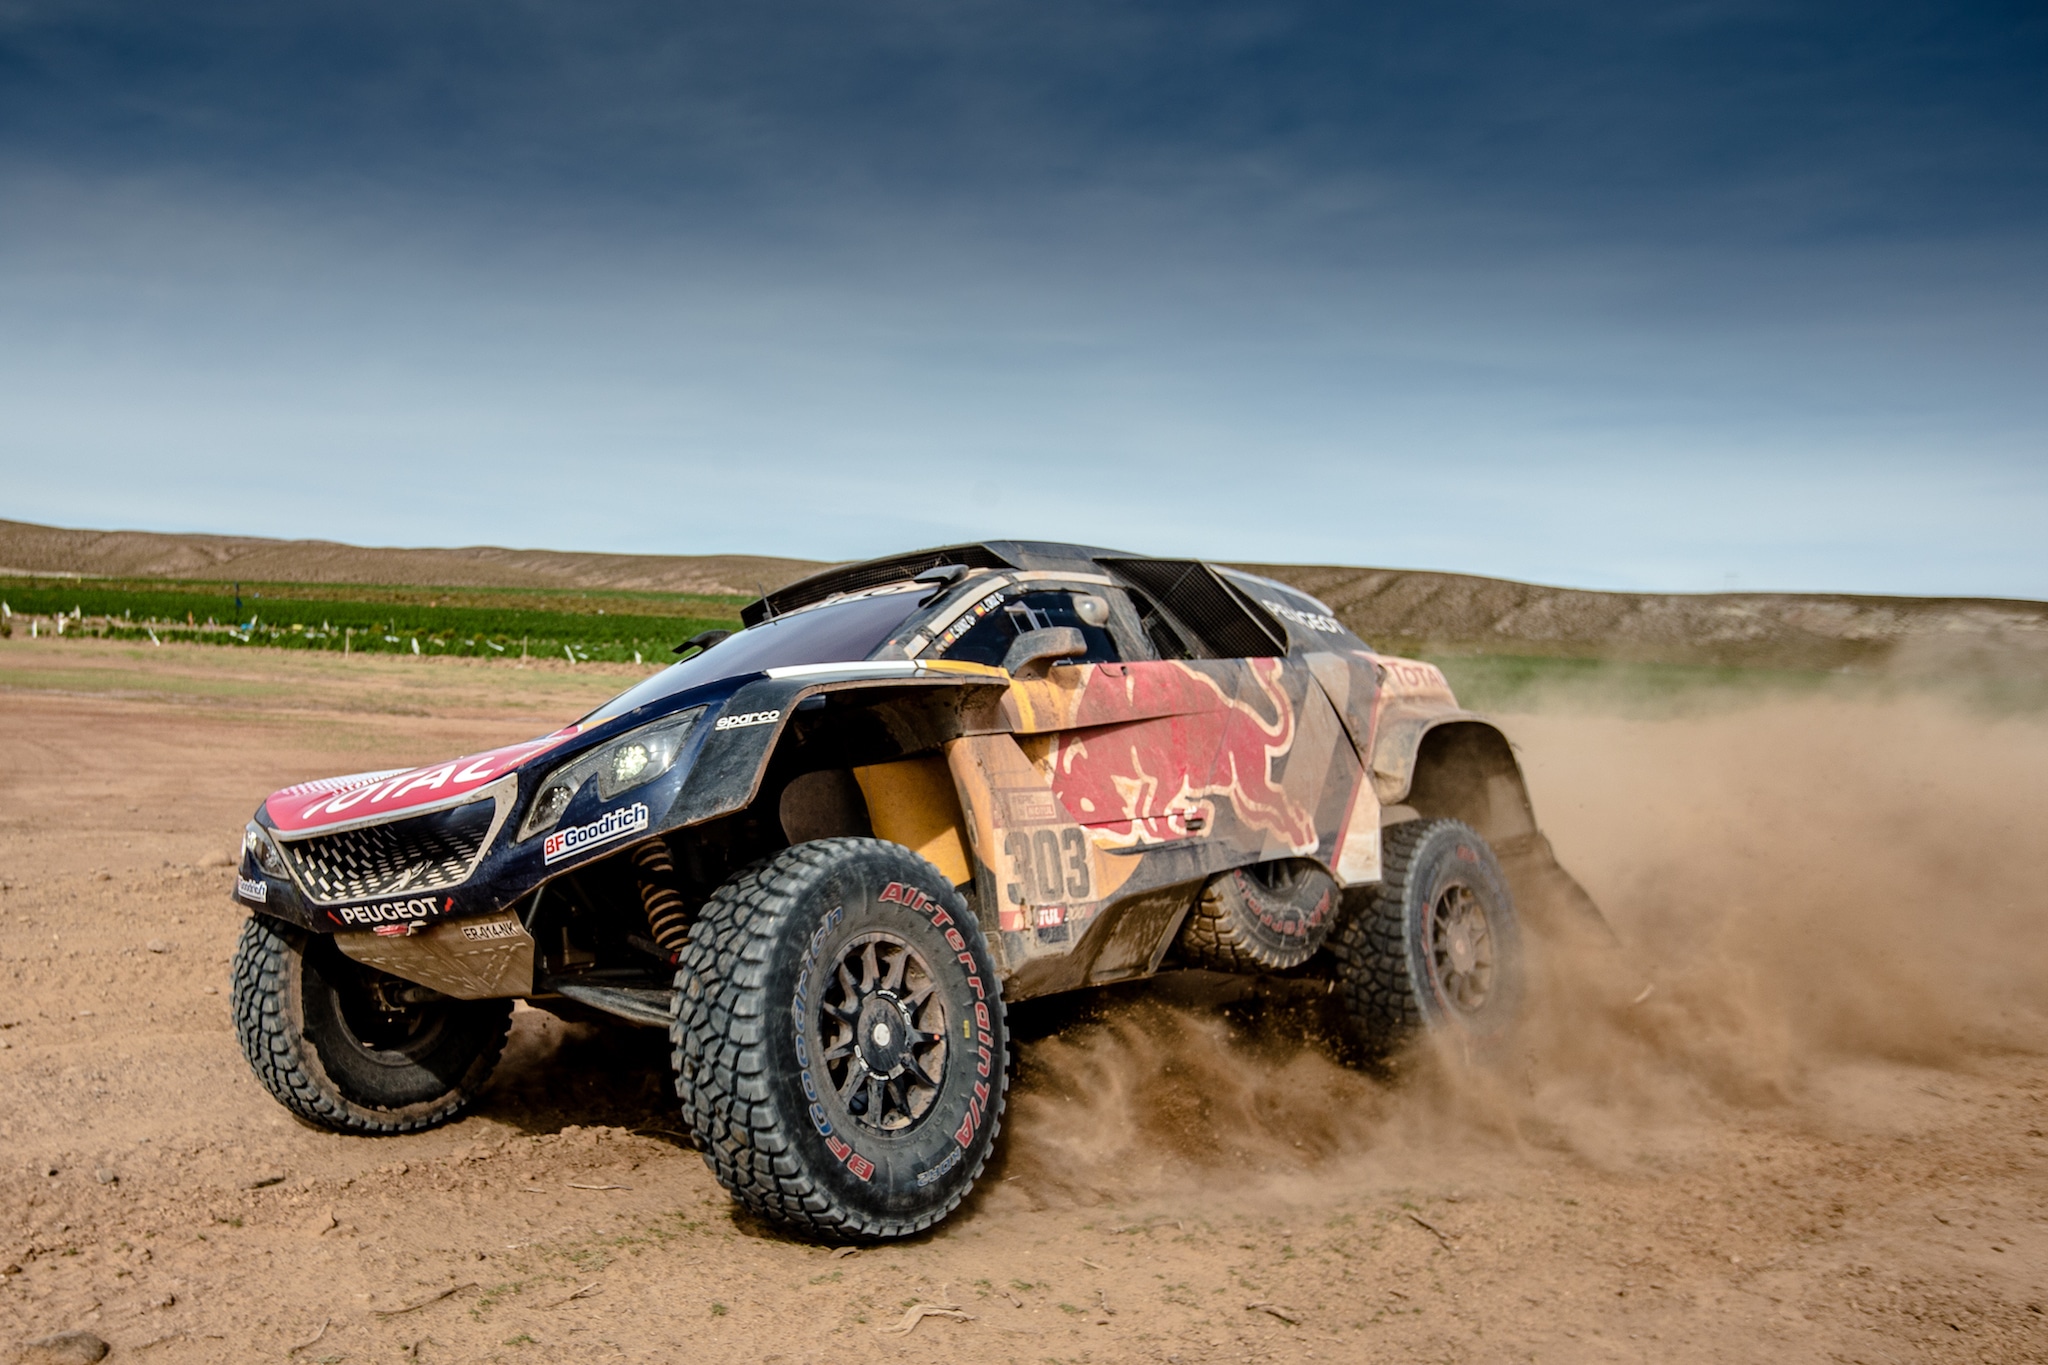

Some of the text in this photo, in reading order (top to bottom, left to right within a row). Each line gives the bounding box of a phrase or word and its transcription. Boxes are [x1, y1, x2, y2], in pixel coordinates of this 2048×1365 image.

[1261, 599, 1345, 634] PEUGEOT
[715, 709, 780, 730] sparco
[302, 756, 495, 820] TOTAL
[545, 806, 646, 856] BFGoodrich
[1004, 827, 1090, 906] 303
[340, 897, 439, 925] PEUGEOT
[463, 922, 518, 941] ER-014-NK
[878, 881, 993, 1078] All-Terrain
